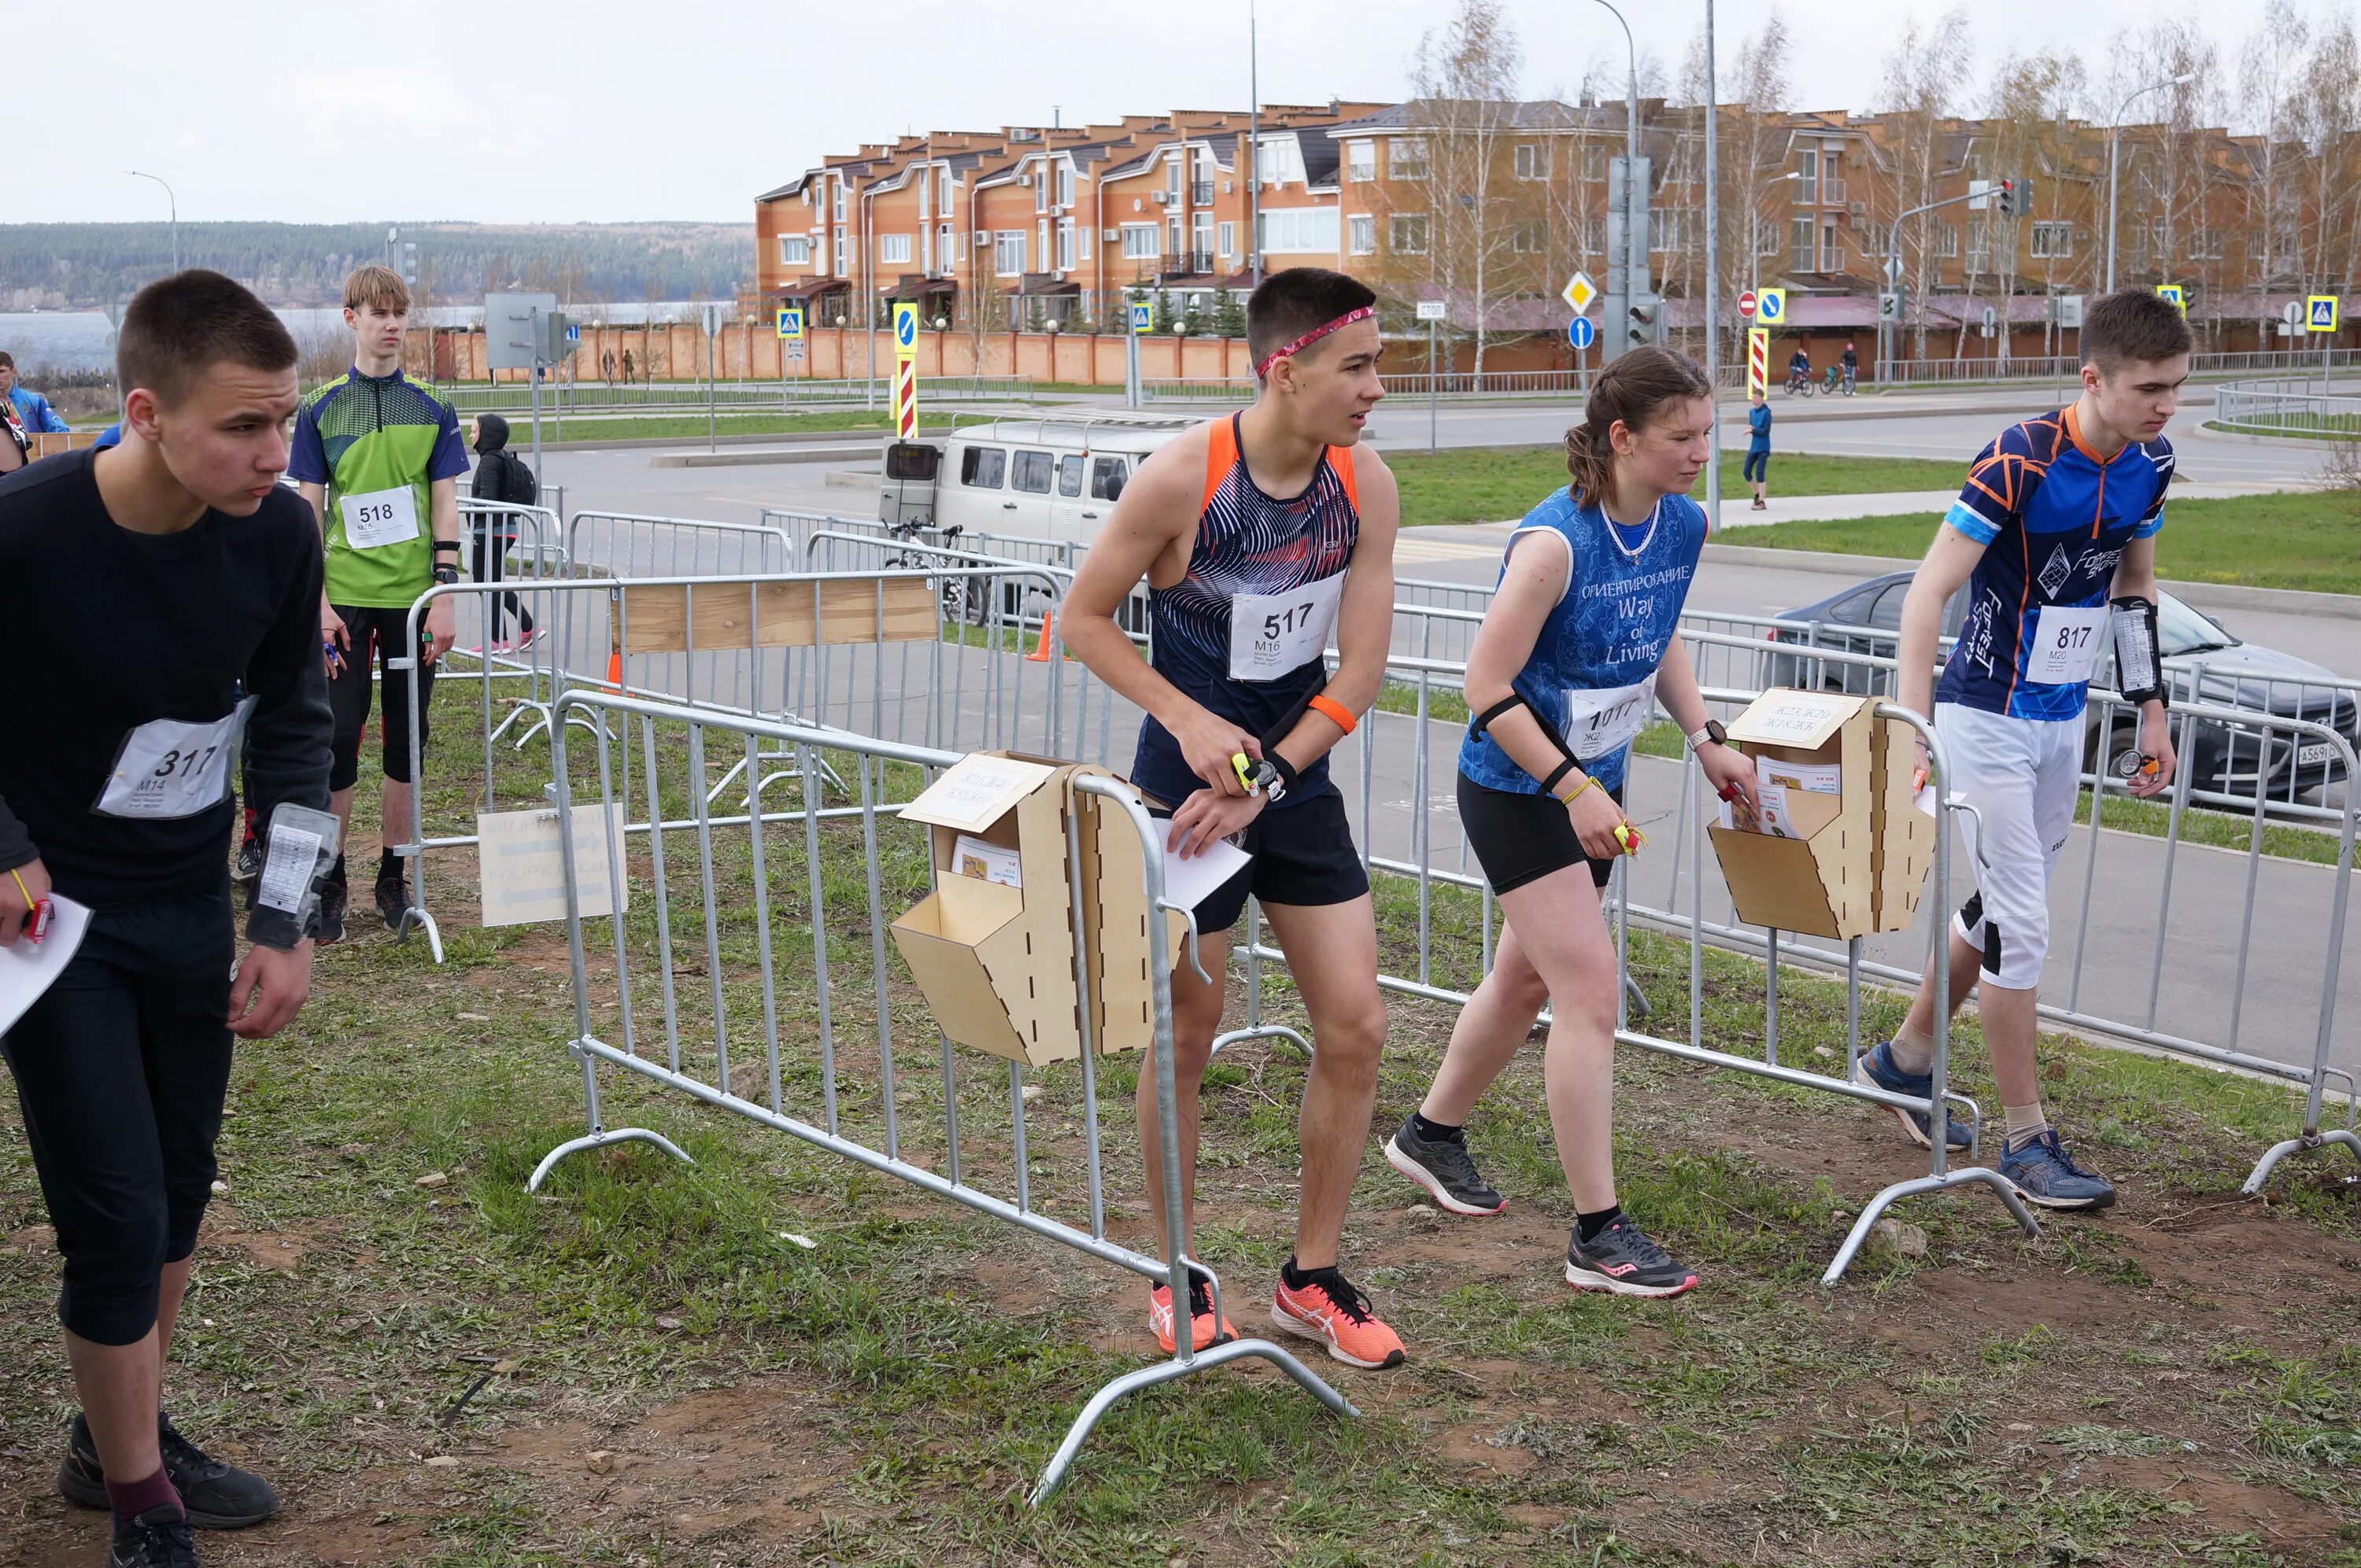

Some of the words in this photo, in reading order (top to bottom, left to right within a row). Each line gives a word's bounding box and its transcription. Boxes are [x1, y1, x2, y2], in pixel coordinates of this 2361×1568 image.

[1421, 304, 1442, 316] СТОП
[360, 504, 393, 523] 518
[1618, 595, 1654, 619] Way
[1264, 602, 1314, 640] 517
[1631, 620, 1644, 640] of
[1254, 640, 1280, 652] М16
[2057, 626, 2092, 649] 817
[1605, 640, 1660, 665] Living
[2049, 651, 2067, 660] М20
[1590, 696, 1640, 731] 1017
[1583, 732, 1603, 743] Ж2
[154, 745, 217, 778] 317
[136, 780, 166, 791] М14
